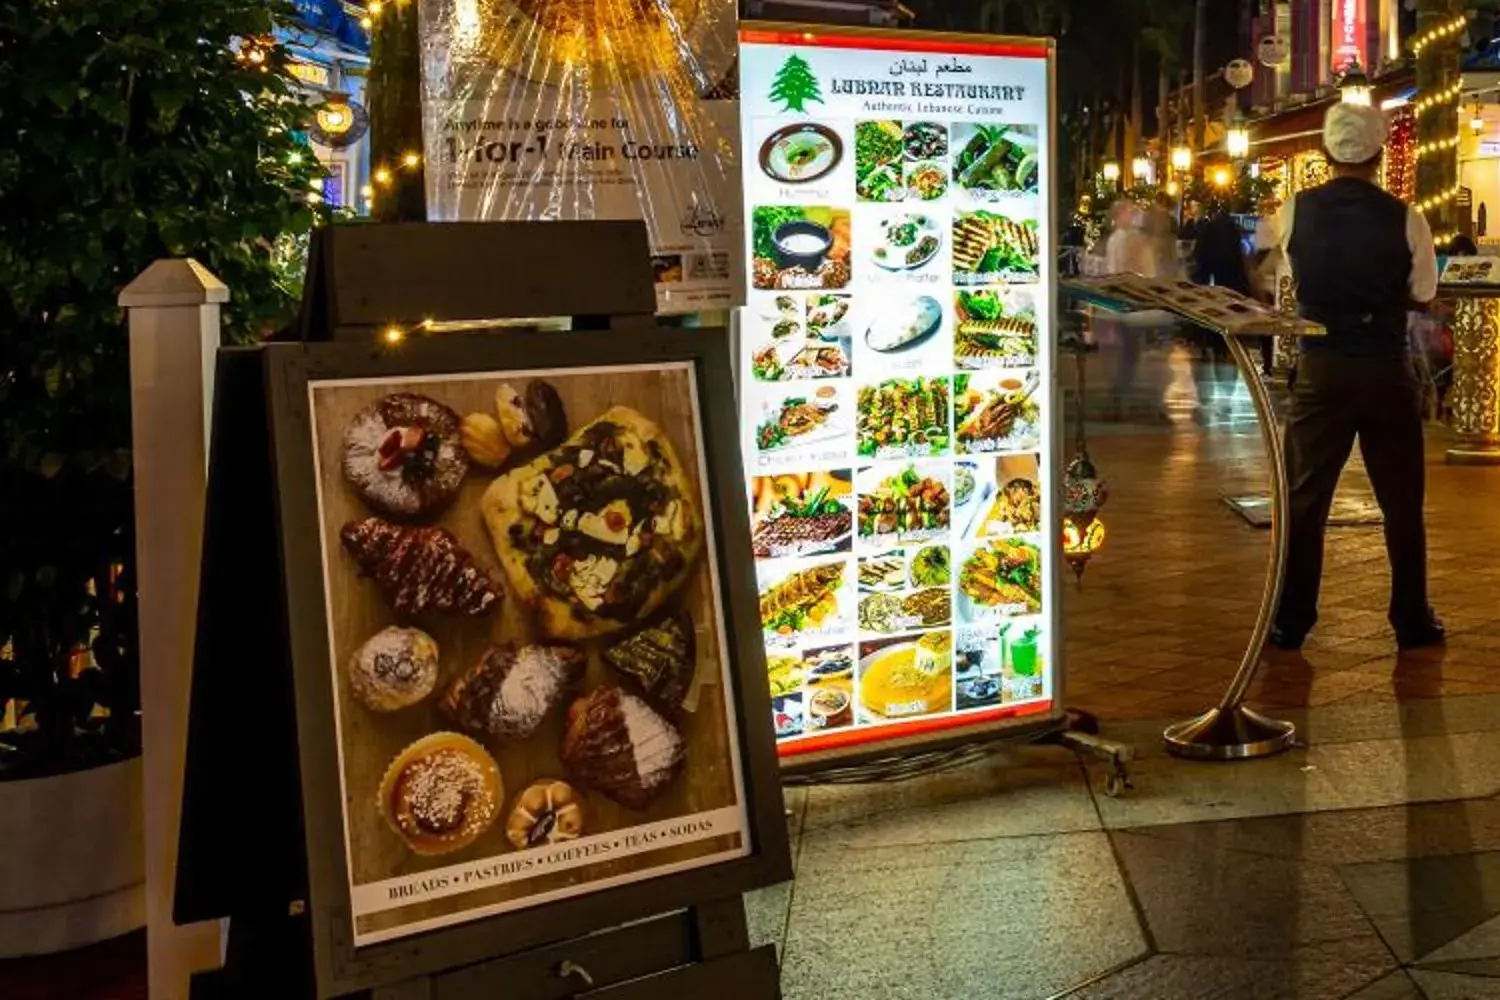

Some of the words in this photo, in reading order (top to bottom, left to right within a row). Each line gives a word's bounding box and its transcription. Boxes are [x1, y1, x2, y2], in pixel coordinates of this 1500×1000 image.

[911, 82, 1025, 101] RESTAURANT
[862, 101, 913, 113] Authentic
[621, 140, 699, 162] Course
[388, 874, 449, 901] BREADS
[464, 856, 534, 884] PASTRIES
[546, 841, 612, 865] COFFEES
[623, 829, 658, 849] TEAS
[668, 818, 713, 839] SODAS
